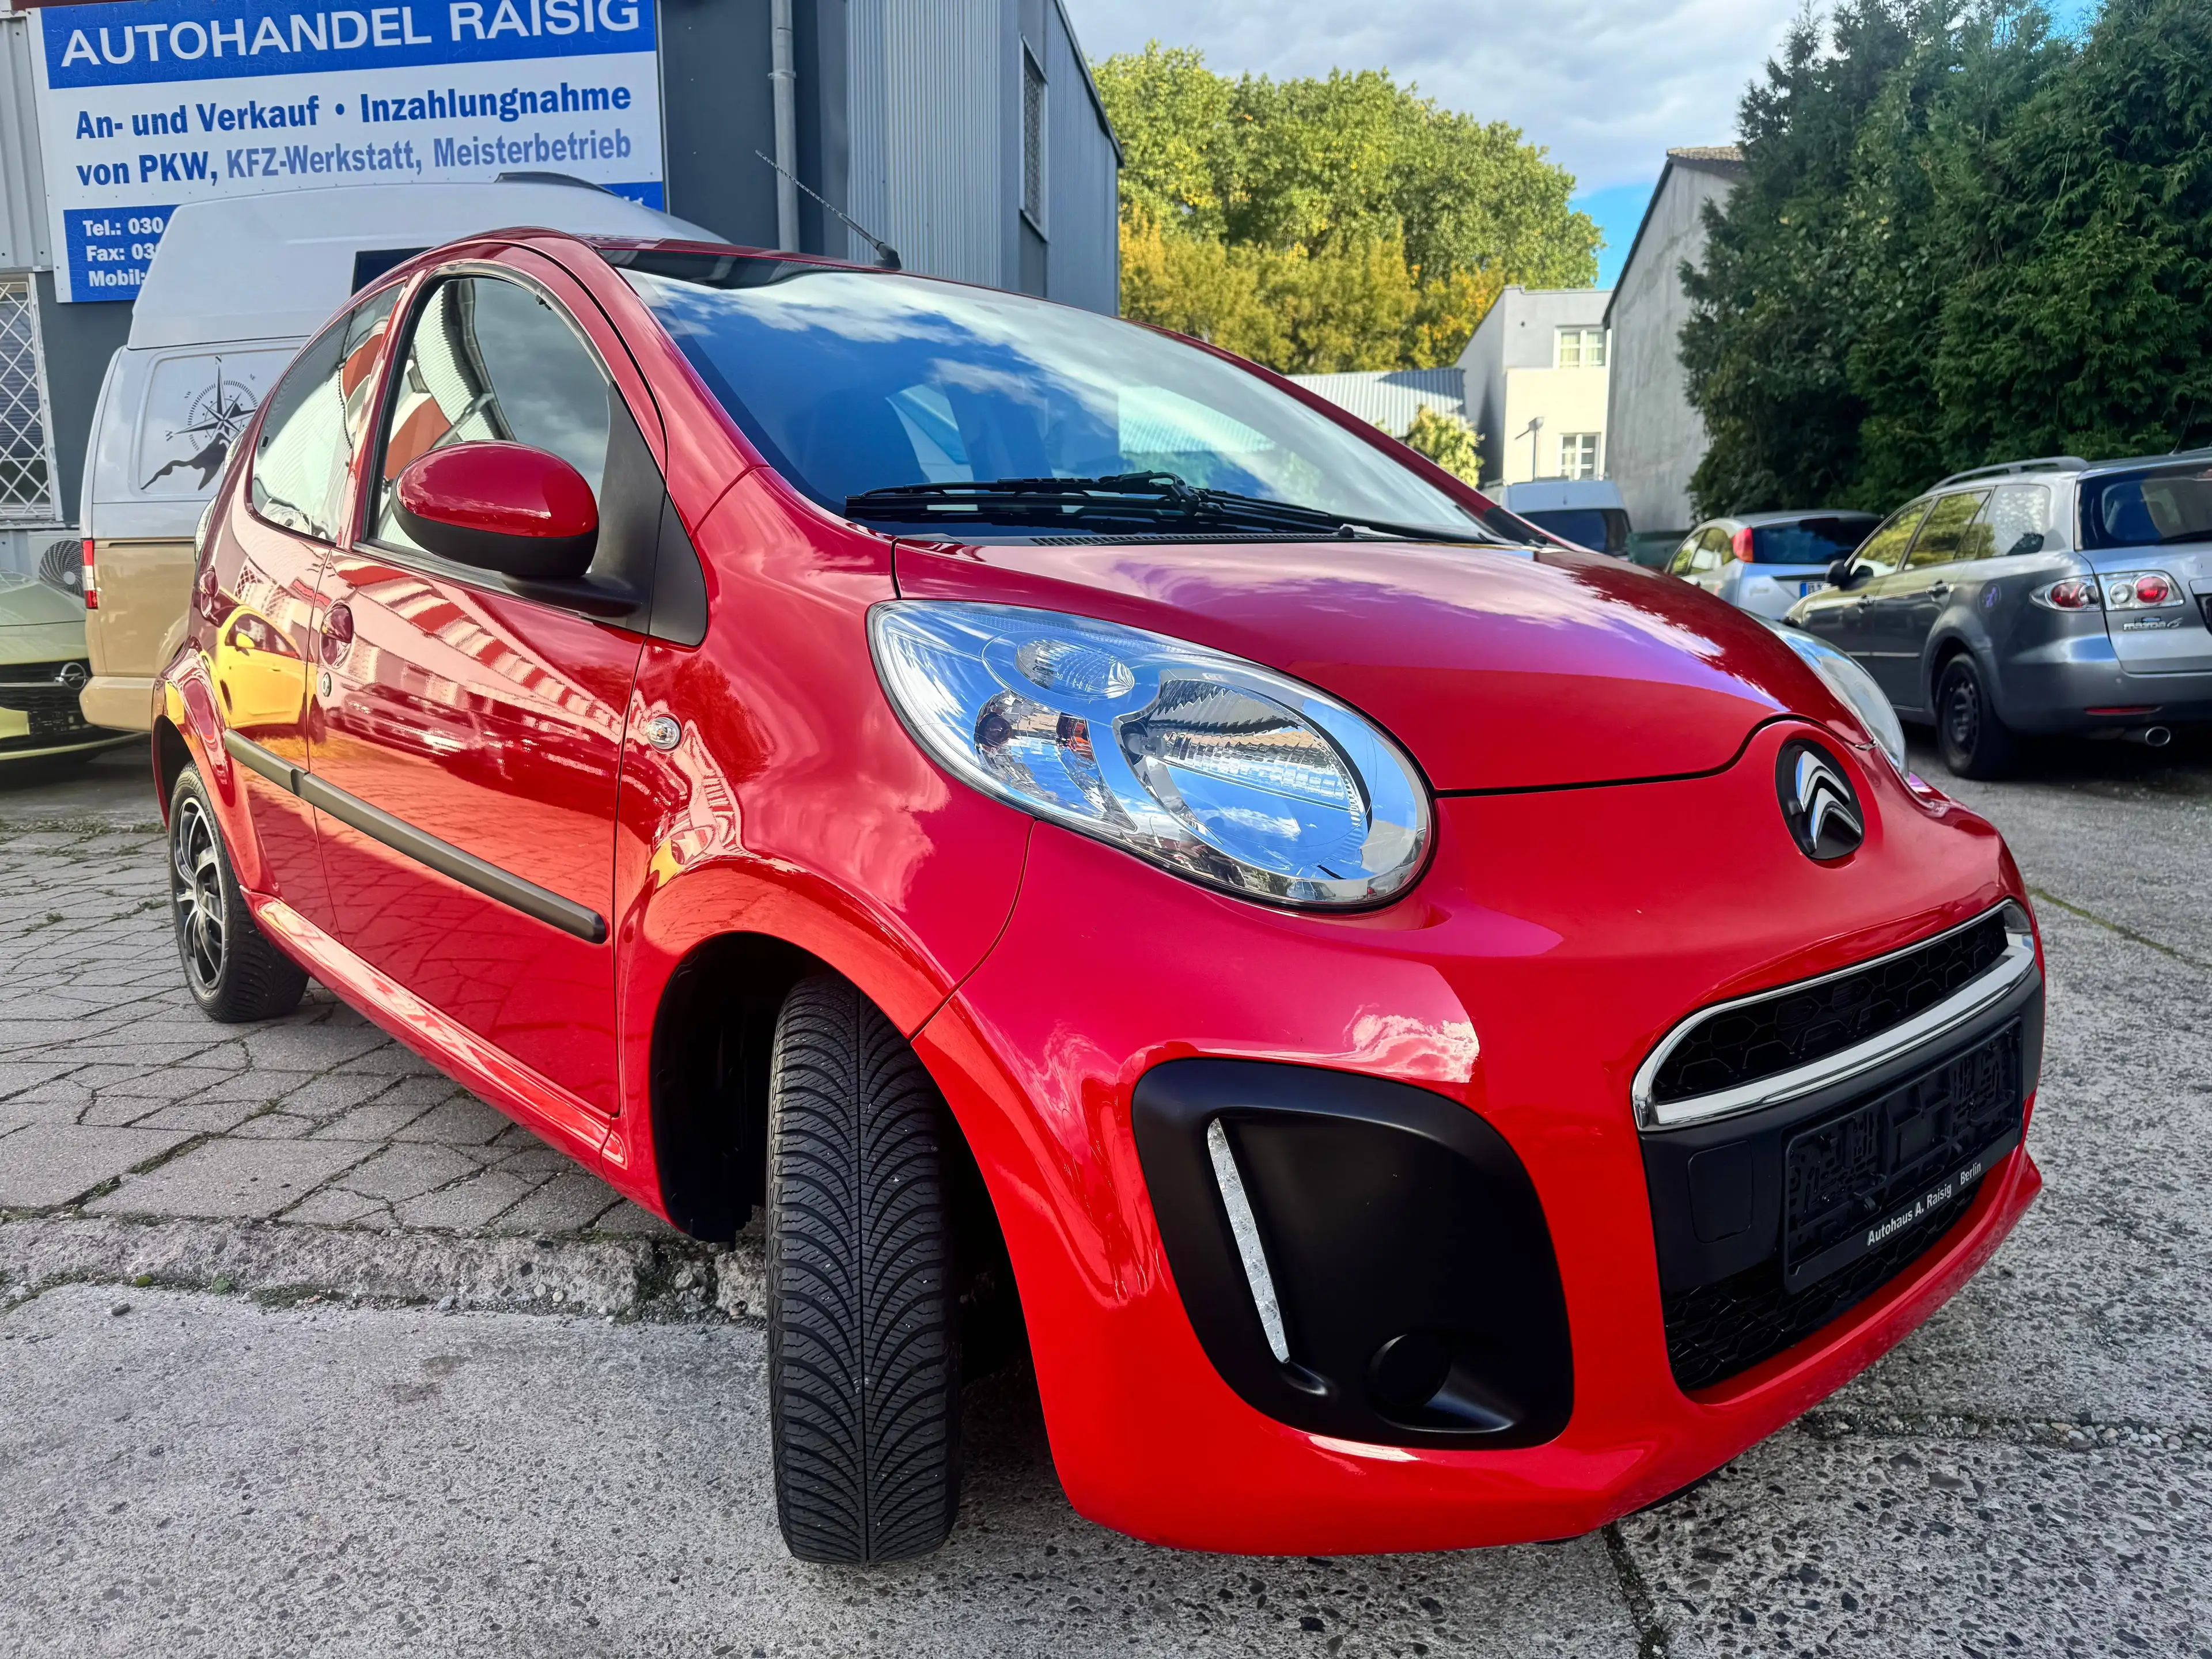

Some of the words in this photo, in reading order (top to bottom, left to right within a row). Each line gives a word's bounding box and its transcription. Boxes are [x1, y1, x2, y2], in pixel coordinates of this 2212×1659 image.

[60, 6, 432, 67] AUTOHANDEL
[449, 0, 640, 41] RAISIG
[76, 110, 123, 139] An-
[132, 104, 188, 135] und
[196, 95, 320, 132] Verkauf
[361, 82, 631, 123] Inzahlungnahme
[76, 162, 130, 186] von
[139, 151, 218, 187] PKW,
[226, 139, 422, 179] KFZ-Werkstatt,
[434, 128, 631, 168] Meisterbetrieb
[82, 219, 122, 236] Tel.:
[128, 217, 164, 234] 030
[86, 245, 125, 262] Fax:
[215, 355, 222, 365] N
[1866, 1210, 1913, 1247] Autohaus
[1915, 1202, 1925, 1218] A.
[1926, 1183, 1952, 1209] Raisig
[1960, 1162, 1982, 1185] Berlin
